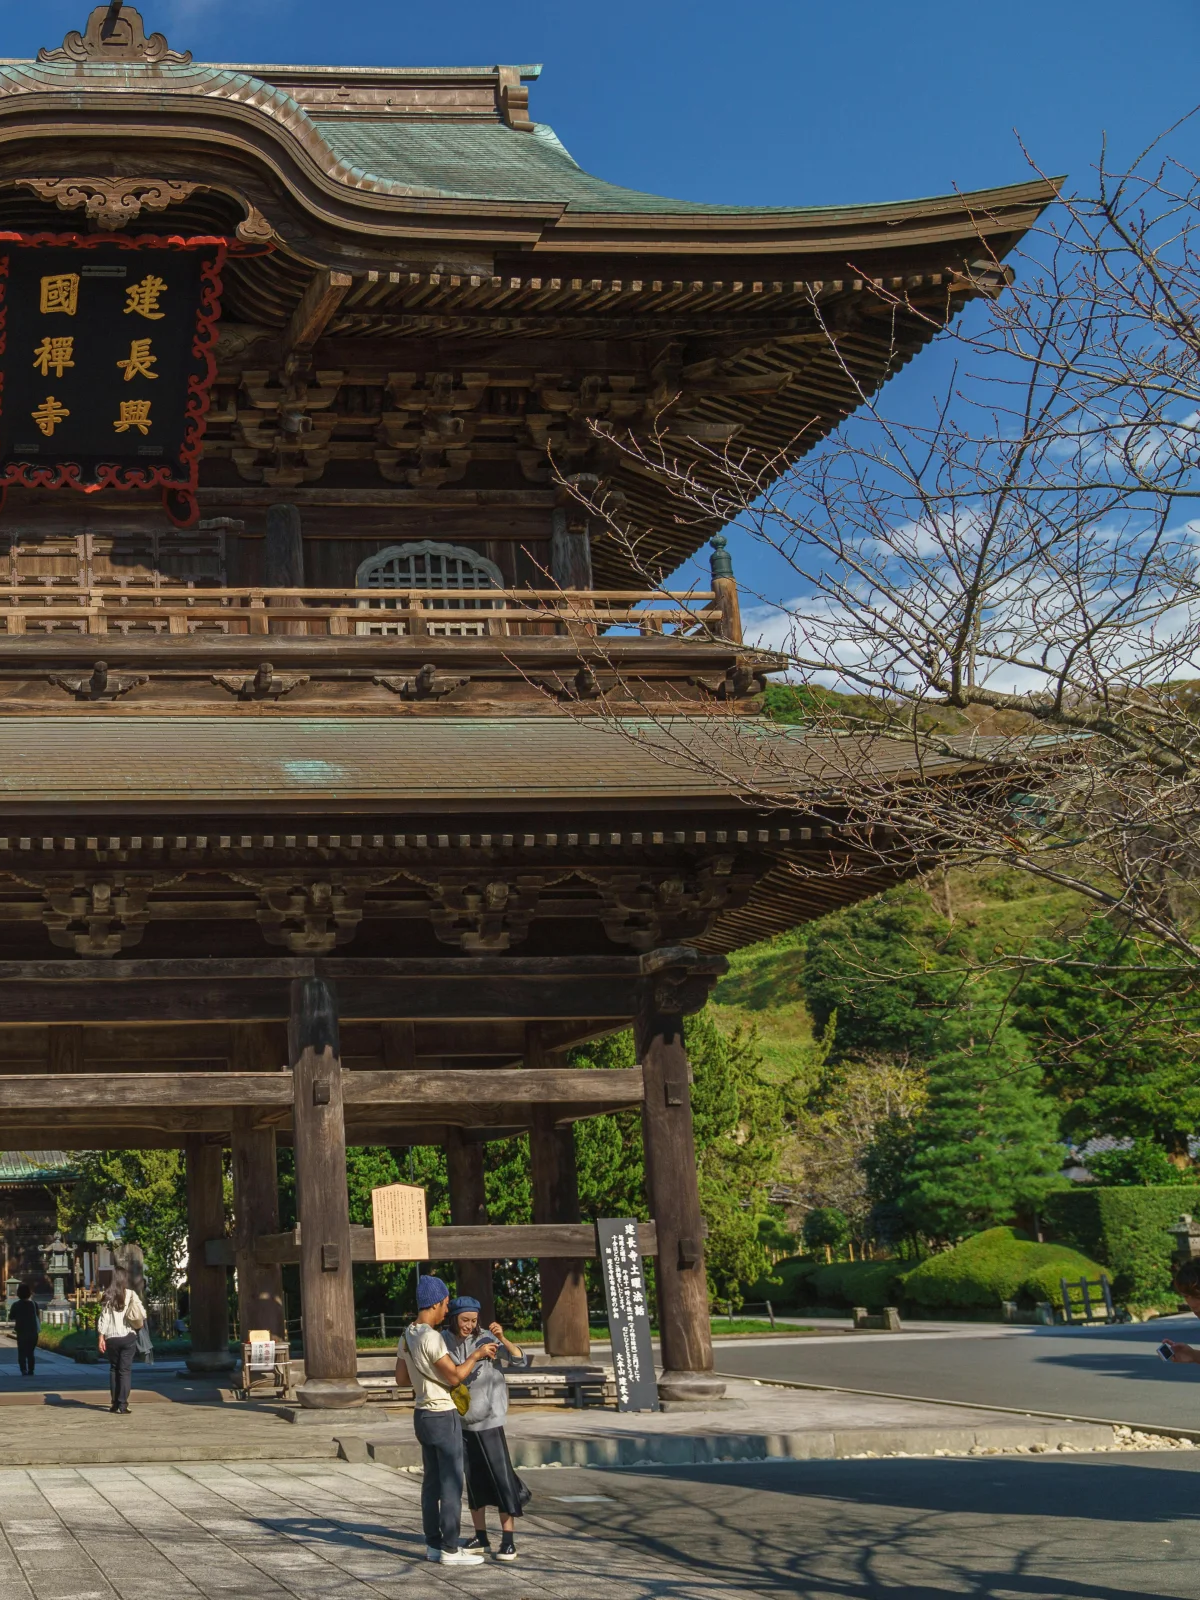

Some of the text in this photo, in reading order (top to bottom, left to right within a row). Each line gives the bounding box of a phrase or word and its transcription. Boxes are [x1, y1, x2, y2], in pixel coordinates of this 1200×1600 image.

[624, 1223, 645, 1316] 建長寺土曜法話
